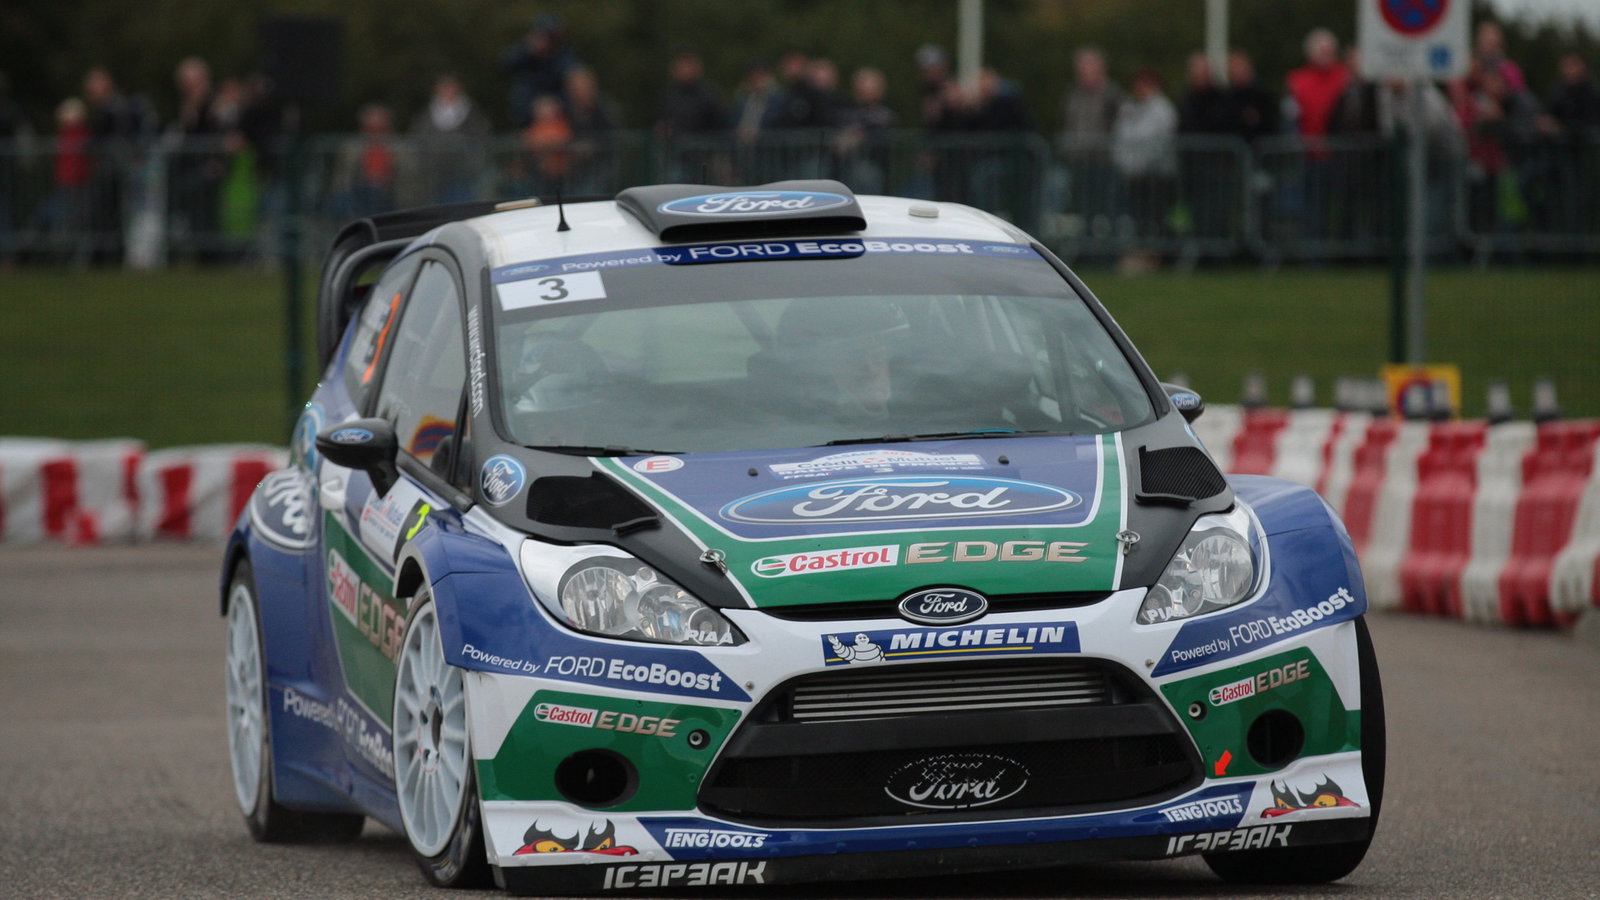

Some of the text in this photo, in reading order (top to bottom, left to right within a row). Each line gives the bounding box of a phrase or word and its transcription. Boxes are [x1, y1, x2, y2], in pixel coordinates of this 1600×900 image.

[696, 194, 815, 213] Ford
[561, 240, 975, 271] Powered by FORD EcoBoost
[538, 278, 569, 301] 3
[483, 460, 517, 500] Ford
[646, 459, 671, 471] E
[797, 459, 860, 469] Crédit
[792, 480, 1012, 518] Ford
[788, 541, 1093, 573] Castrol EDGE
[919, 593, 968, 614] Ford
[889, 626, 1066, 651] MICHELIN
[1171, 586, 1355, 663] Powered by FORD EcoBoost
[461, 643, 722, 692] Powered by FORD EcoBoost
[1221, 658, 1311, 702] Castrol EDGE
[549, 706, 681, 738] Castrol EDGE
[908, 761, 1007, 801] Ford
